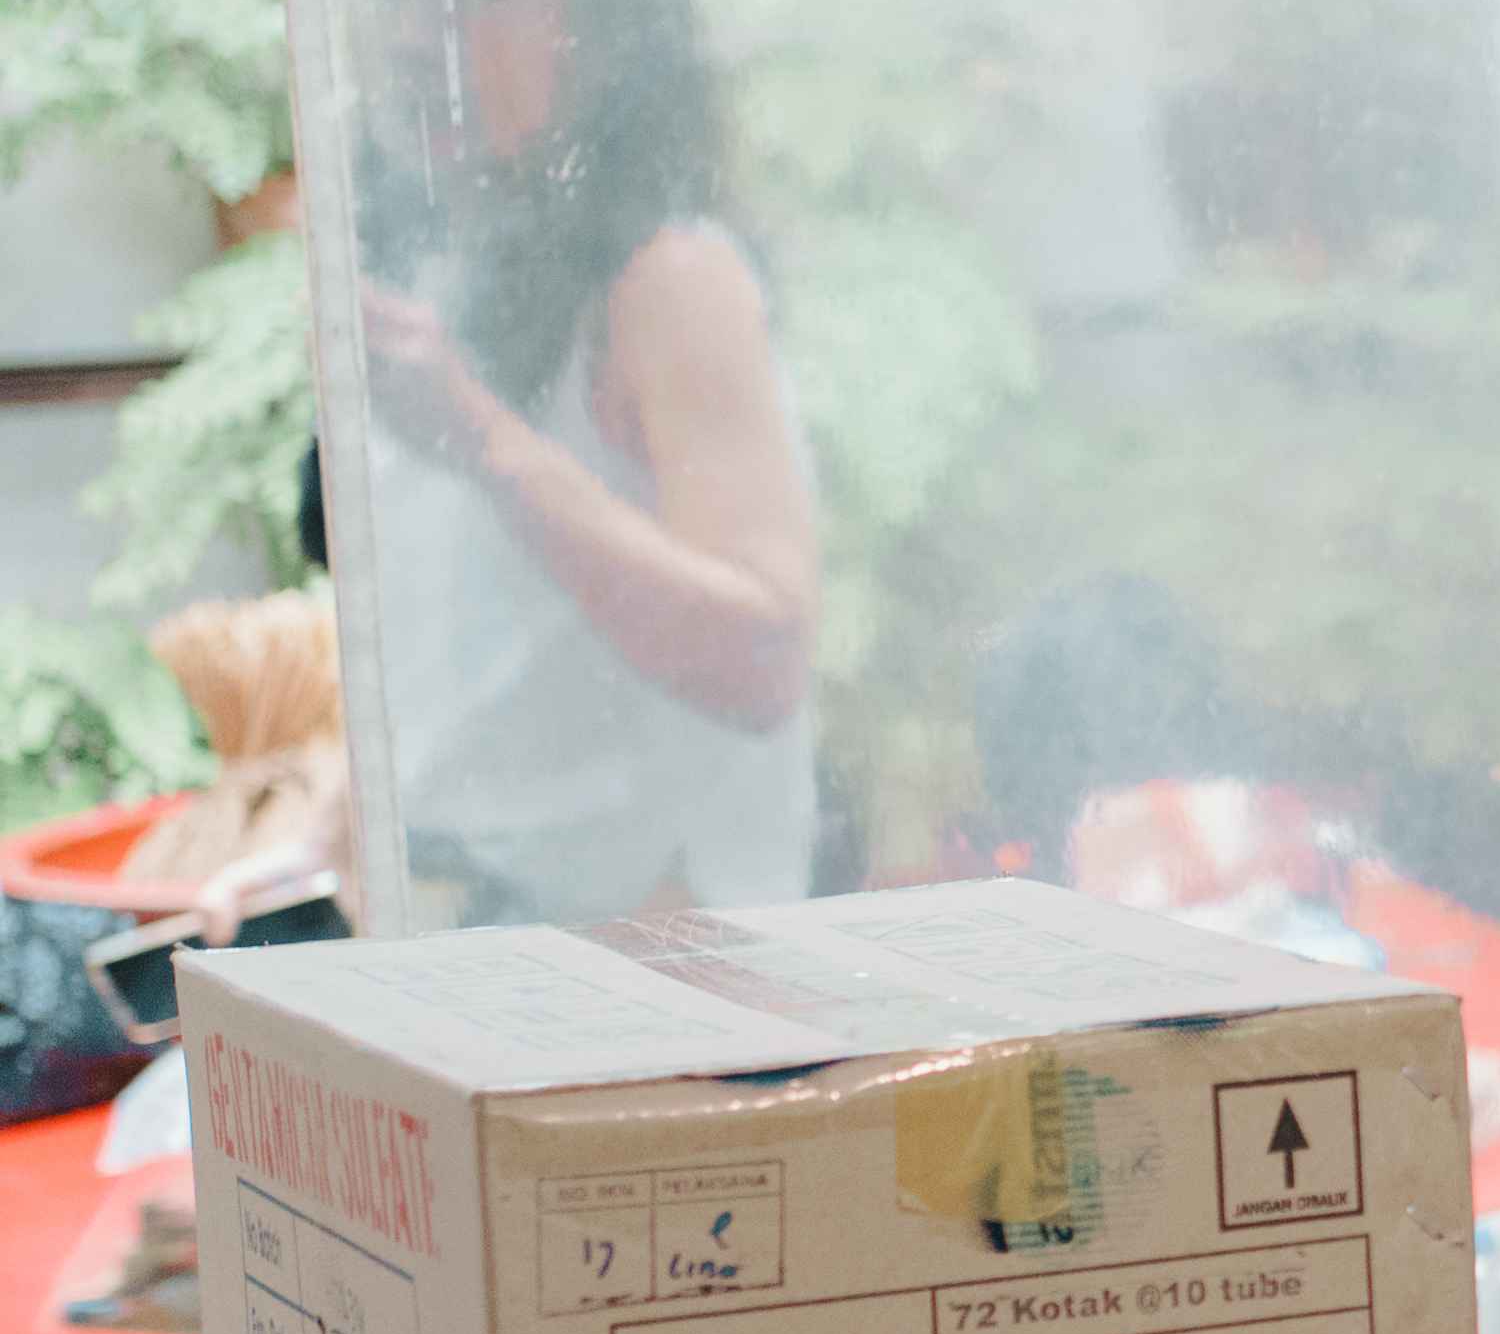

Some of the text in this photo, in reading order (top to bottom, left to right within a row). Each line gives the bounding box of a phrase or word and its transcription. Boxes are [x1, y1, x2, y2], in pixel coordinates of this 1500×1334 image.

[1234, 1198, 1292, 1218] JANGAN
[949, 1272, 1303, 1331] 72 Kotak @10 tube
